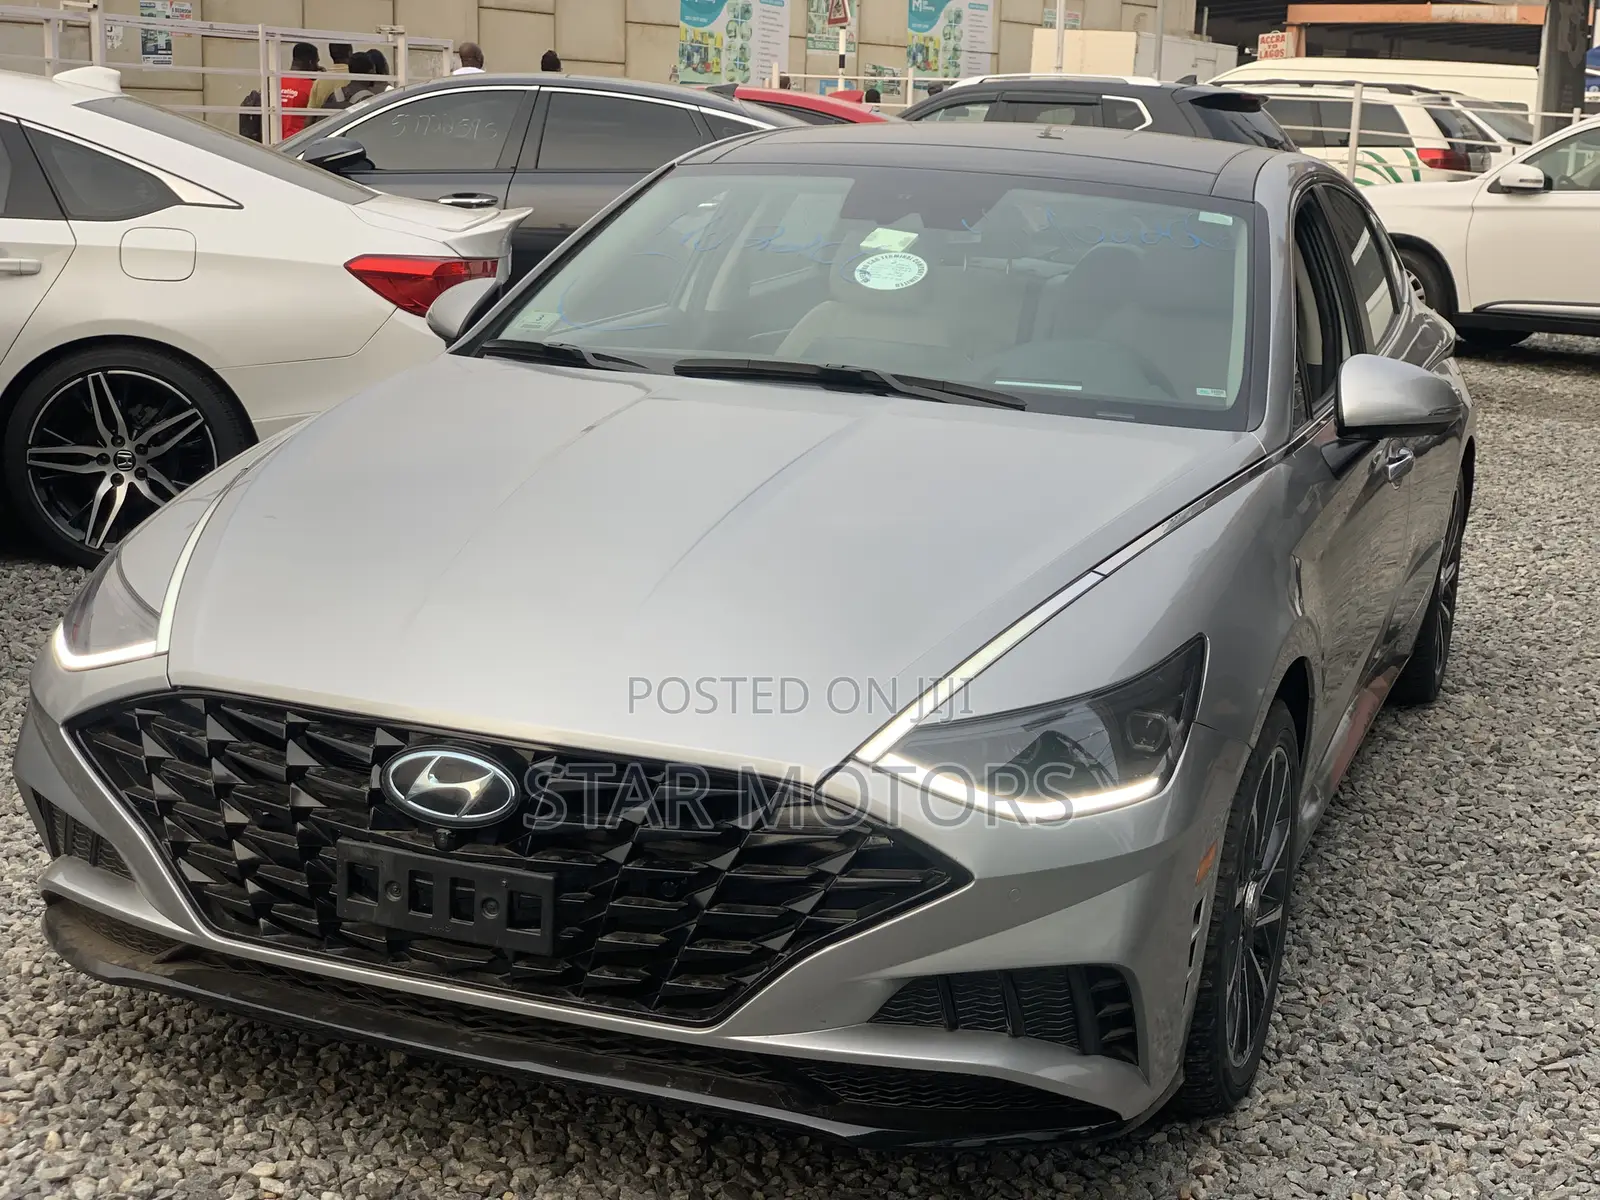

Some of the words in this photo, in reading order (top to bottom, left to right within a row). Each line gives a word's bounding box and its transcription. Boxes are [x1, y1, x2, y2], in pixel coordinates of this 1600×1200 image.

[1260, 35, 1285, 44] ACCRA
[1259, 49, 1284, 58] LAGOS
[881, 253, 914, 261] TERMINAL
